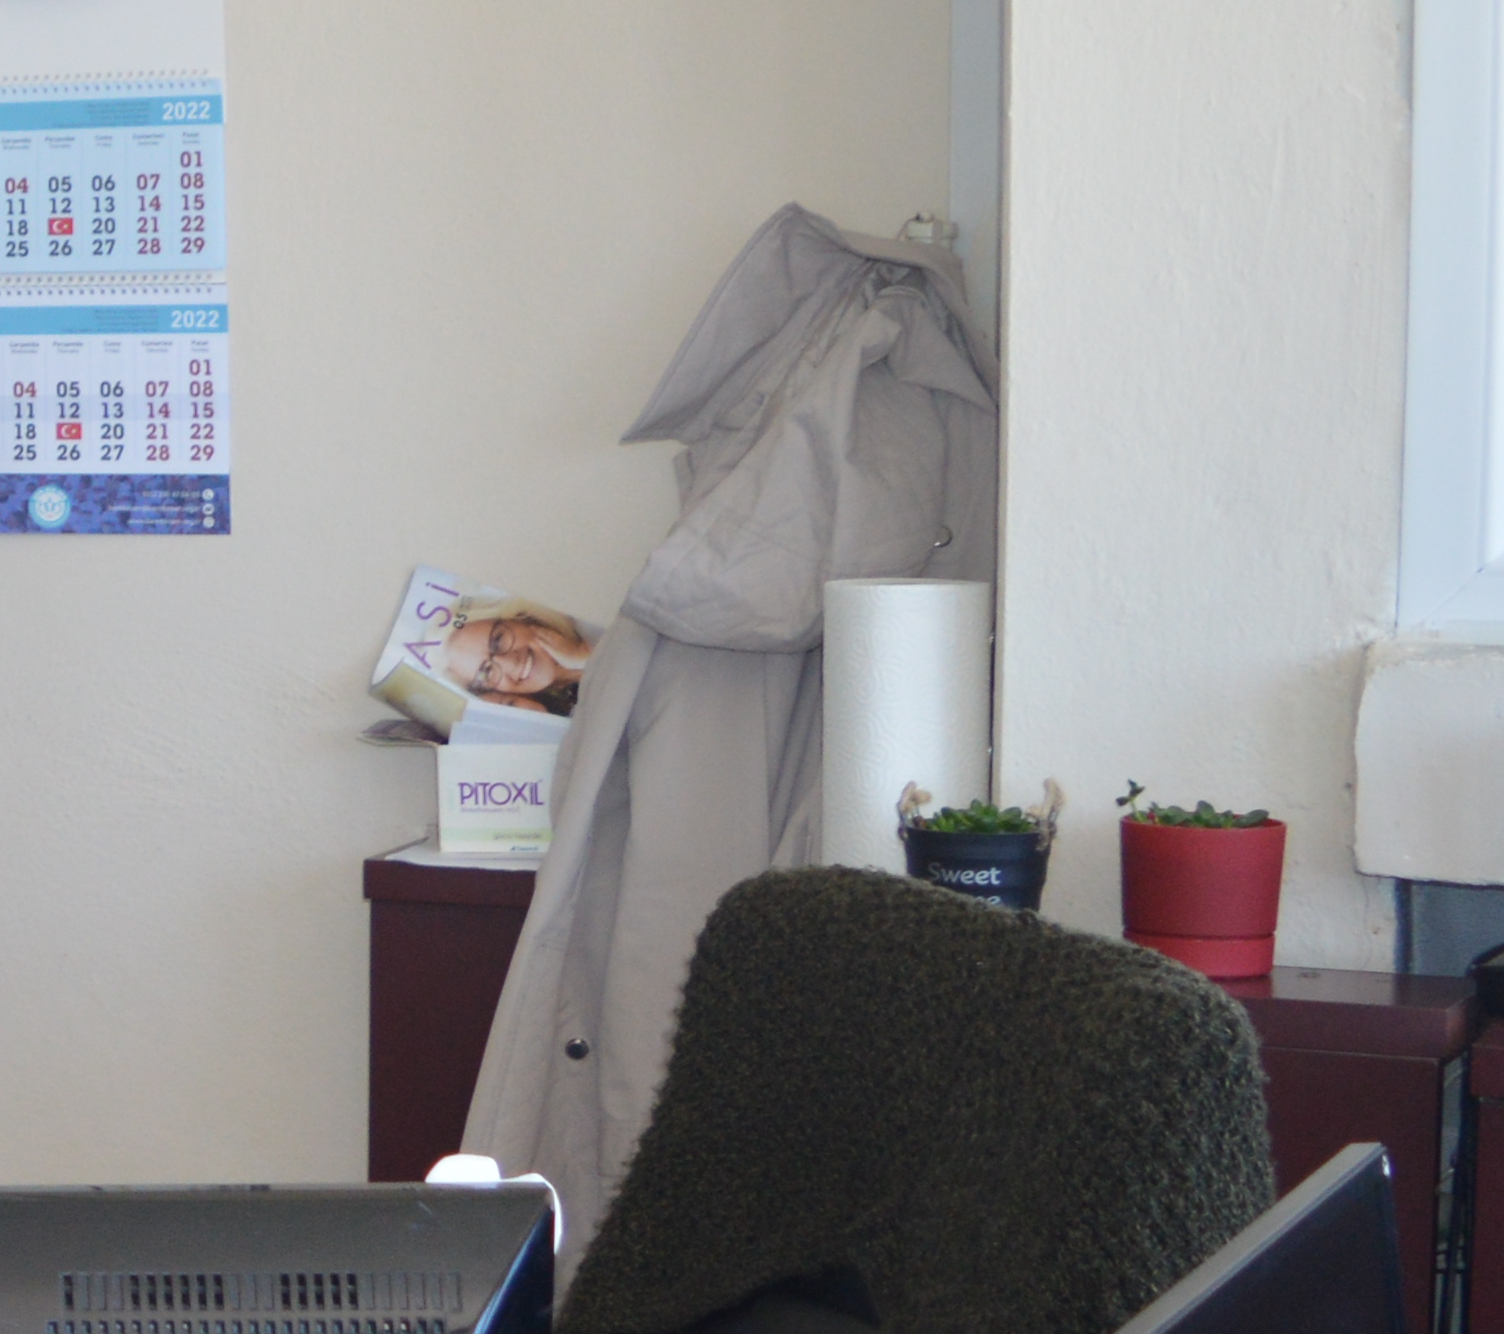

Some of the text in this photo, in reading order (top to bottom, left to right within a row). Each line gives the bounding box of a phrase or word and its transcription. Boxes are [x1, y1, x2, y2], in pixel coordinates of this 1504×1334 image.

[162, 101, 211, 120] 2022
[180, 151, 202, 168] 01
[5, 178, 28, 194] 04
[48, 176, 72, 193] 05
[92, 175, 115, 191] 06
[137, 174, 160, 190] 07
[181, 173, 204, 189] 08
[7, 199, 26, 215] 11
[50, 198, 71, 214] 12
[94, 197, 115, 213] 13
[139, 196, 161, 212] 14
[182, 194, 204, 210] 15
[7, 220, 28, 236] 18
[93, 218, 115, 234] 20
[137, 217, 158, 233] 21
[181, 216, 204, 232] 22
[6, 241, 29, 257] 25
[49, 240, 72, 256] 26
[93, 239, 115, 255] 27
[138, 238, 161, 254] 28
[182, 237, 205, 253] 29
[171, 310, 220, 328] 2022
[189, 359, 211, 375] 01
[14, 382, 36, 398] 04
[57, 382, 80, 398] 05
[100, 381, 123, 397] 06
[145, 381, 168, 397] 07
[190, 381, 213, 397] 08
[15, 403, 34, 419] 11
[59, 403, 79, 418] 12
[102, 402, 123, 418] 13
[148, 402, 170, 418] 14
[192, 402, 214, 418] 15
[16, 424, 36, 439] 18
[101, 423, 124, 439] 20
[147, 423, 167, 439] 21
[191, 423, 214, 439] 22
[14, 445, 36, 460] 25
[58, 445, 80, 460] 26
[101, 445, 123, 460] 27
[147, 445, 169, 461] 28
[191, 445, 214, 461] 29
[928, 862, 1002, 885] Sweet
